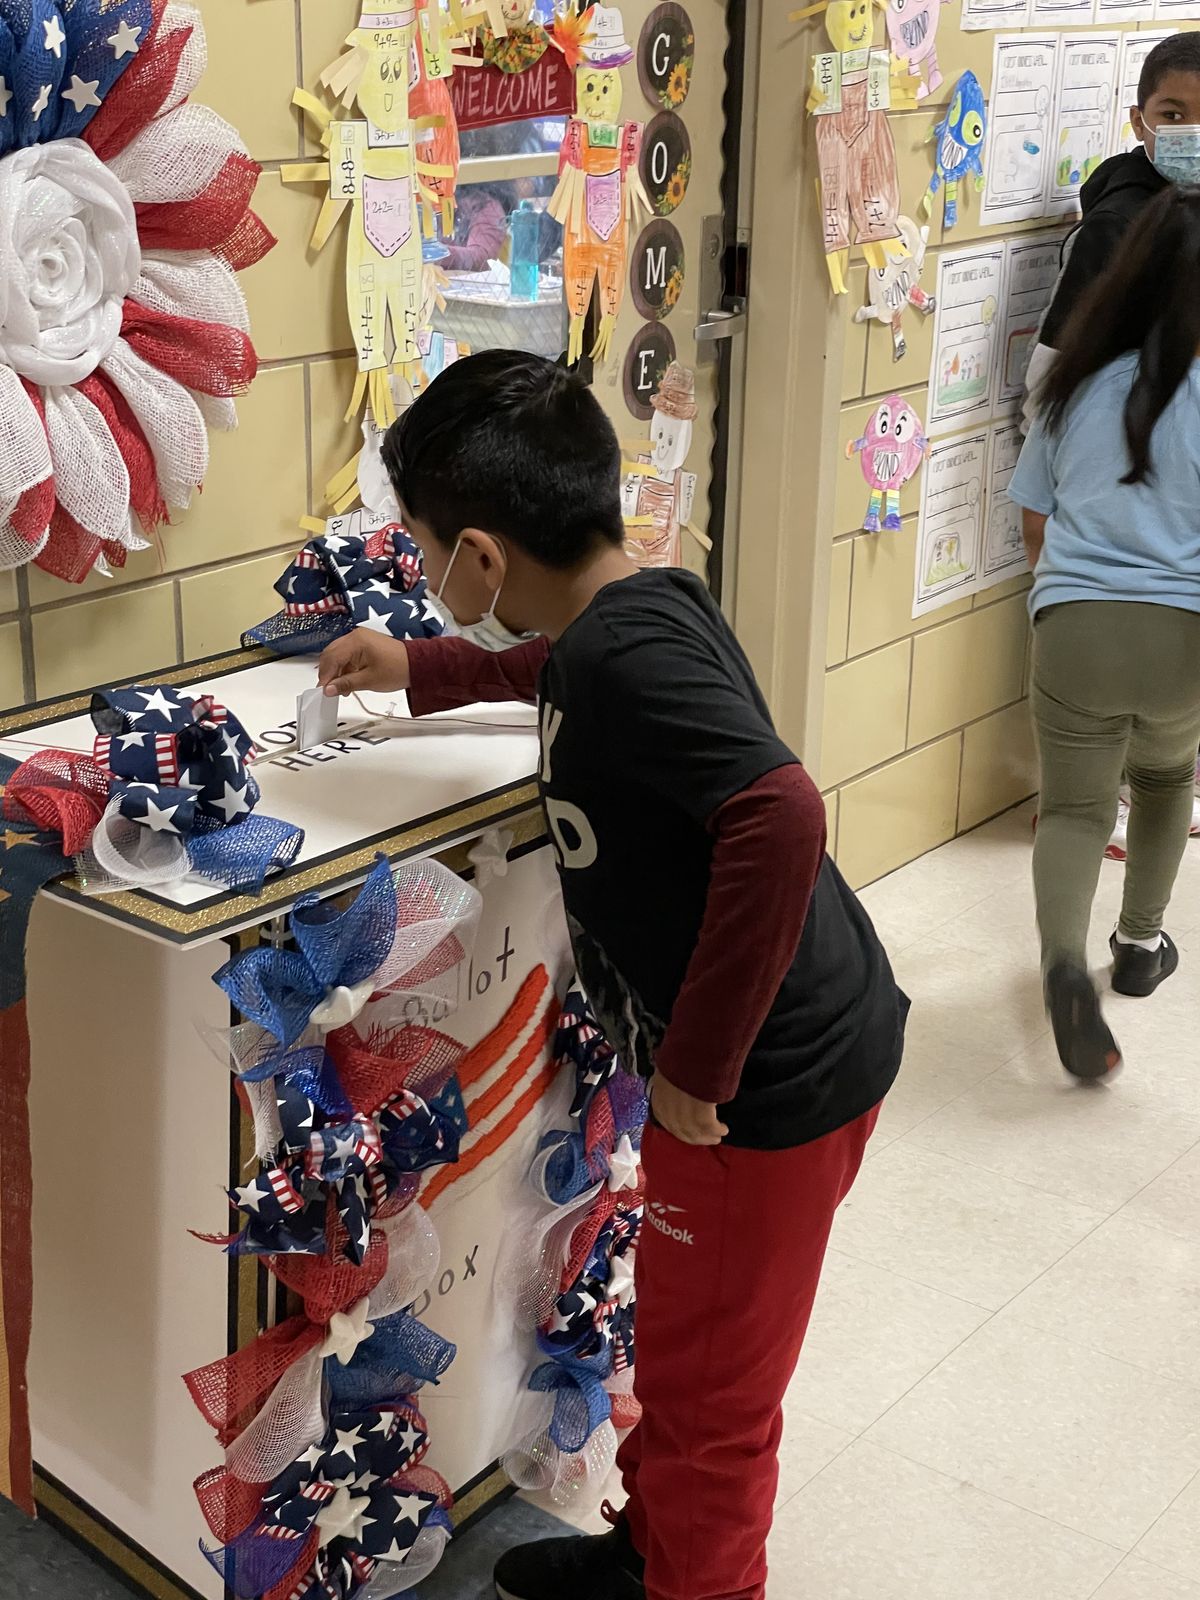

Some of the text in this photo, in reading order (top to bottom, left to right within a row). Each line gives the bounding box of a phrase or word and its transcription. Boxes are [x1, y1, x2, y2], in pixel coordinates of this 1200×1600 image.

[453, 63, 559, 117] WELCOME
[341, 147, 356, 194] 8+8=
[361, 295, 374, 360] 4+4=
[269, 731, 391, 772] HERE
